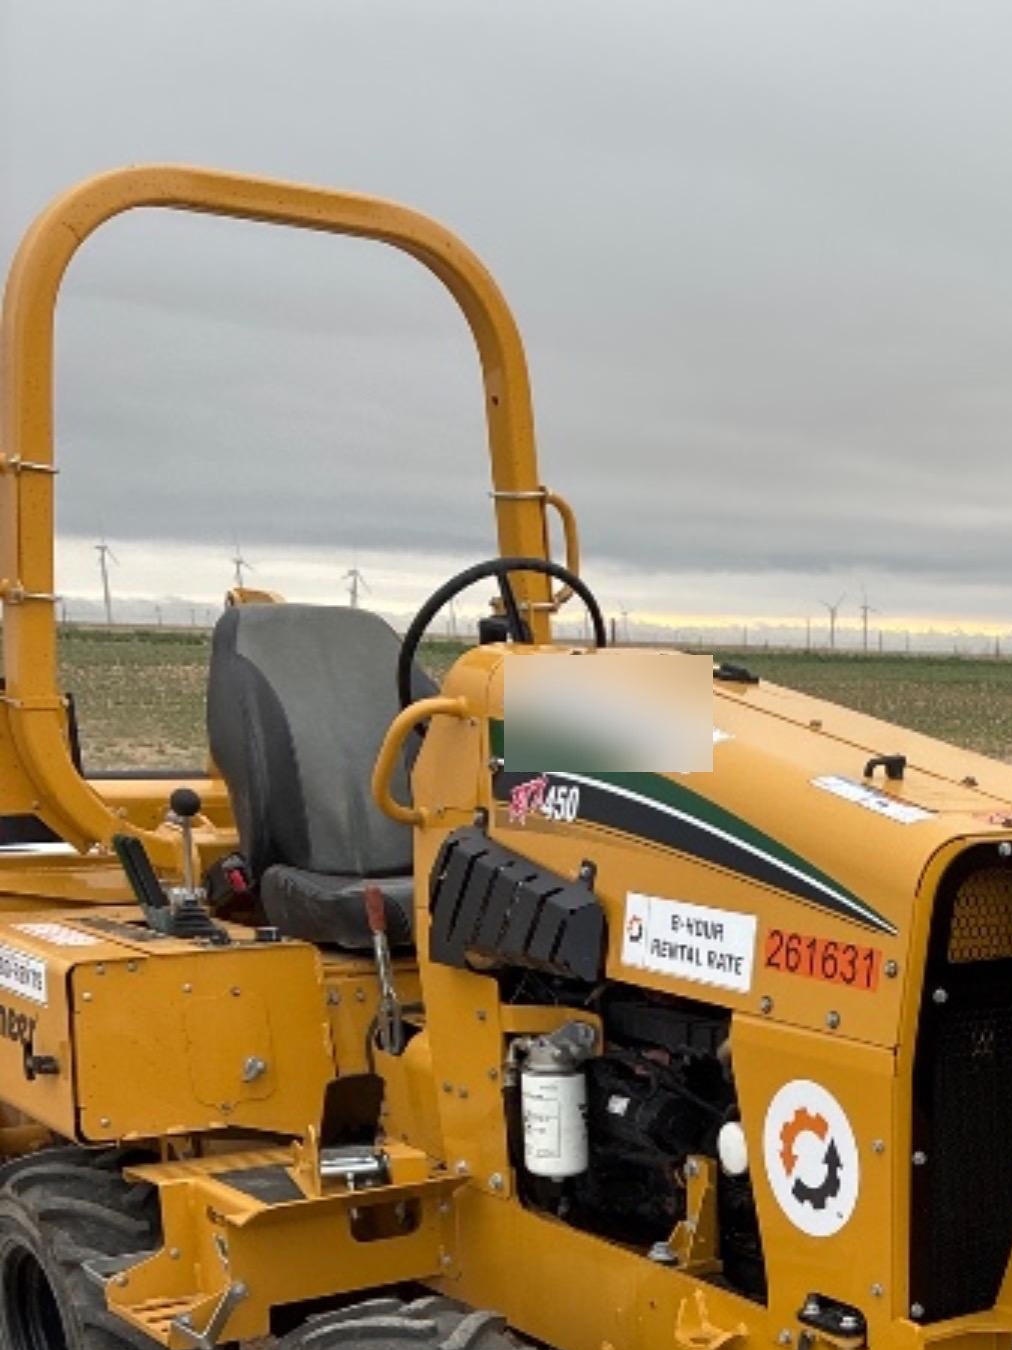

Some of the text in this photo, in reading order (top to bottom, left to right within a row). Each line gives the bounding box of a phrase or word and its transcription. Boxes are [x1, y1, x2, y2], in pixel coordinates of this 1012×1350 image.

[650, 938, 744, 976] RENTAL RATE
[765, 929, 876, 989] 261631
